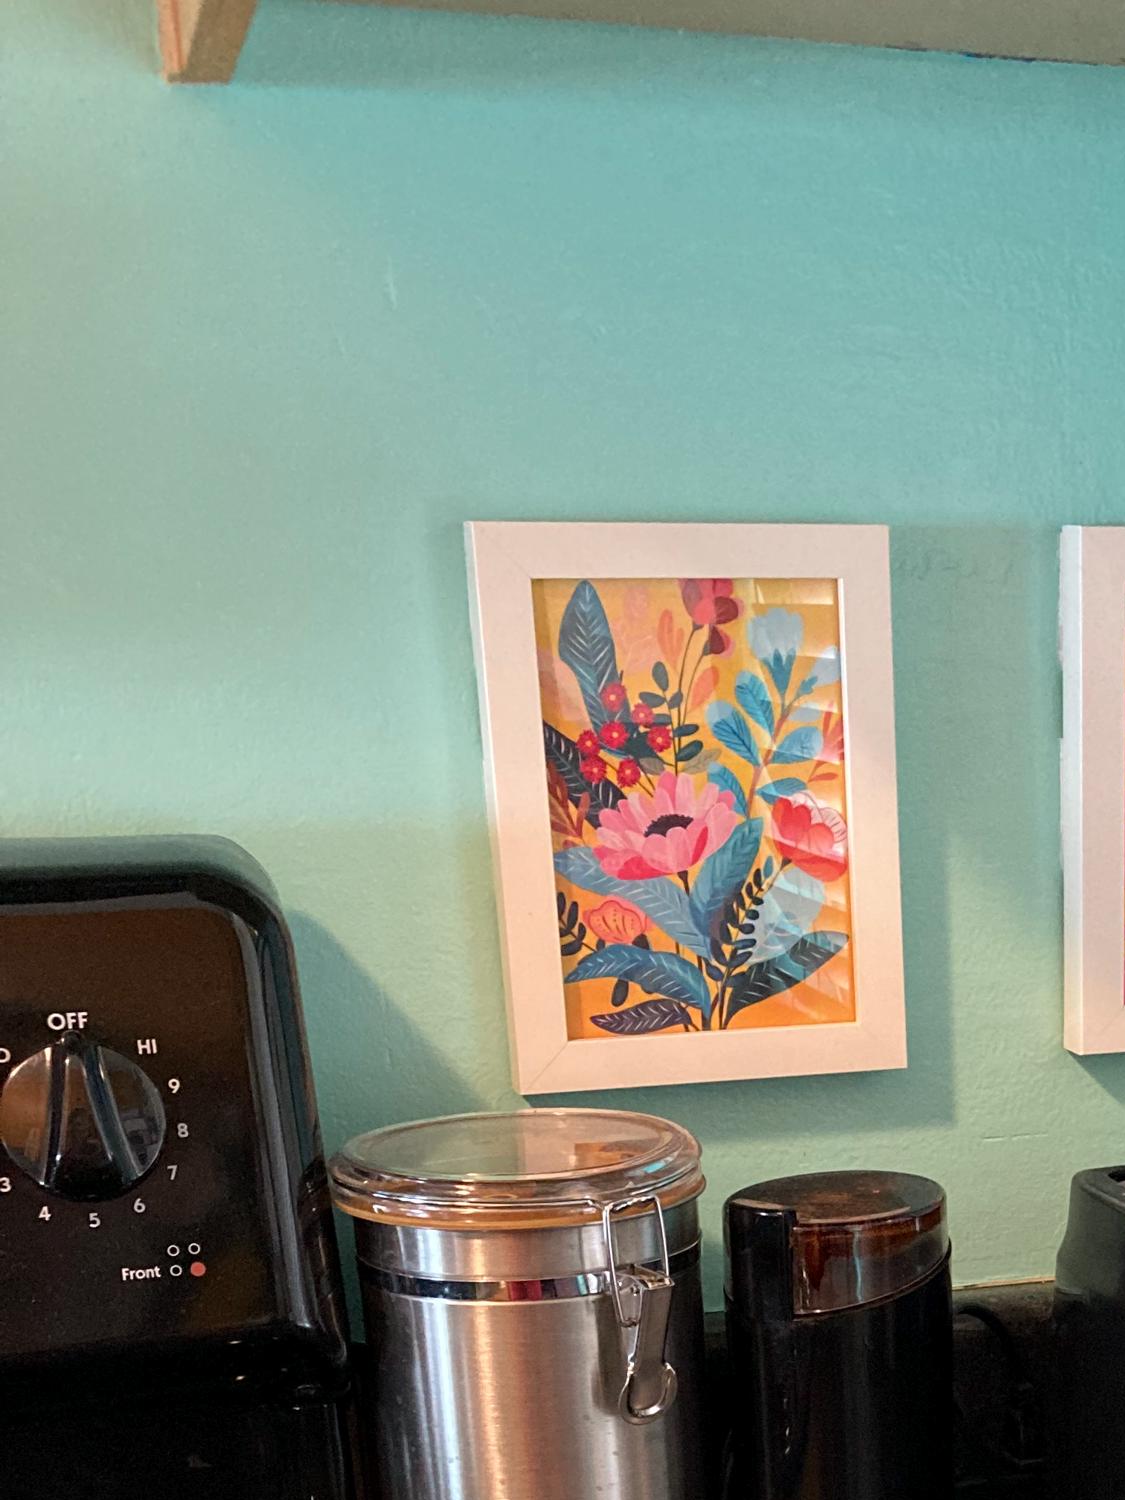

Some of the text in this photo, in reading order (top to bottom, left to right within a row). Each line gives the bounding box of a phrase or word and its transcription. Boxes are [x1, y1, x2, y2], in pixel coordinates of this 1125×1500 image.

[47, 1011, 88, 1031] OFF
[137, 1038, 158, 1055] HI
[168, 1078, 181, 1094] 9
[177, 1122, 189, 1138] 8
[167, 1164, 179, 1181] 7
[0, 1176, 12, 1193] 3
[38, 1204, 52, 1222] 4
[133, 1198, 146, 1213] 6
[89, 1212, 101, 1228] 5
[121, 1265, 162, 1281] Front
